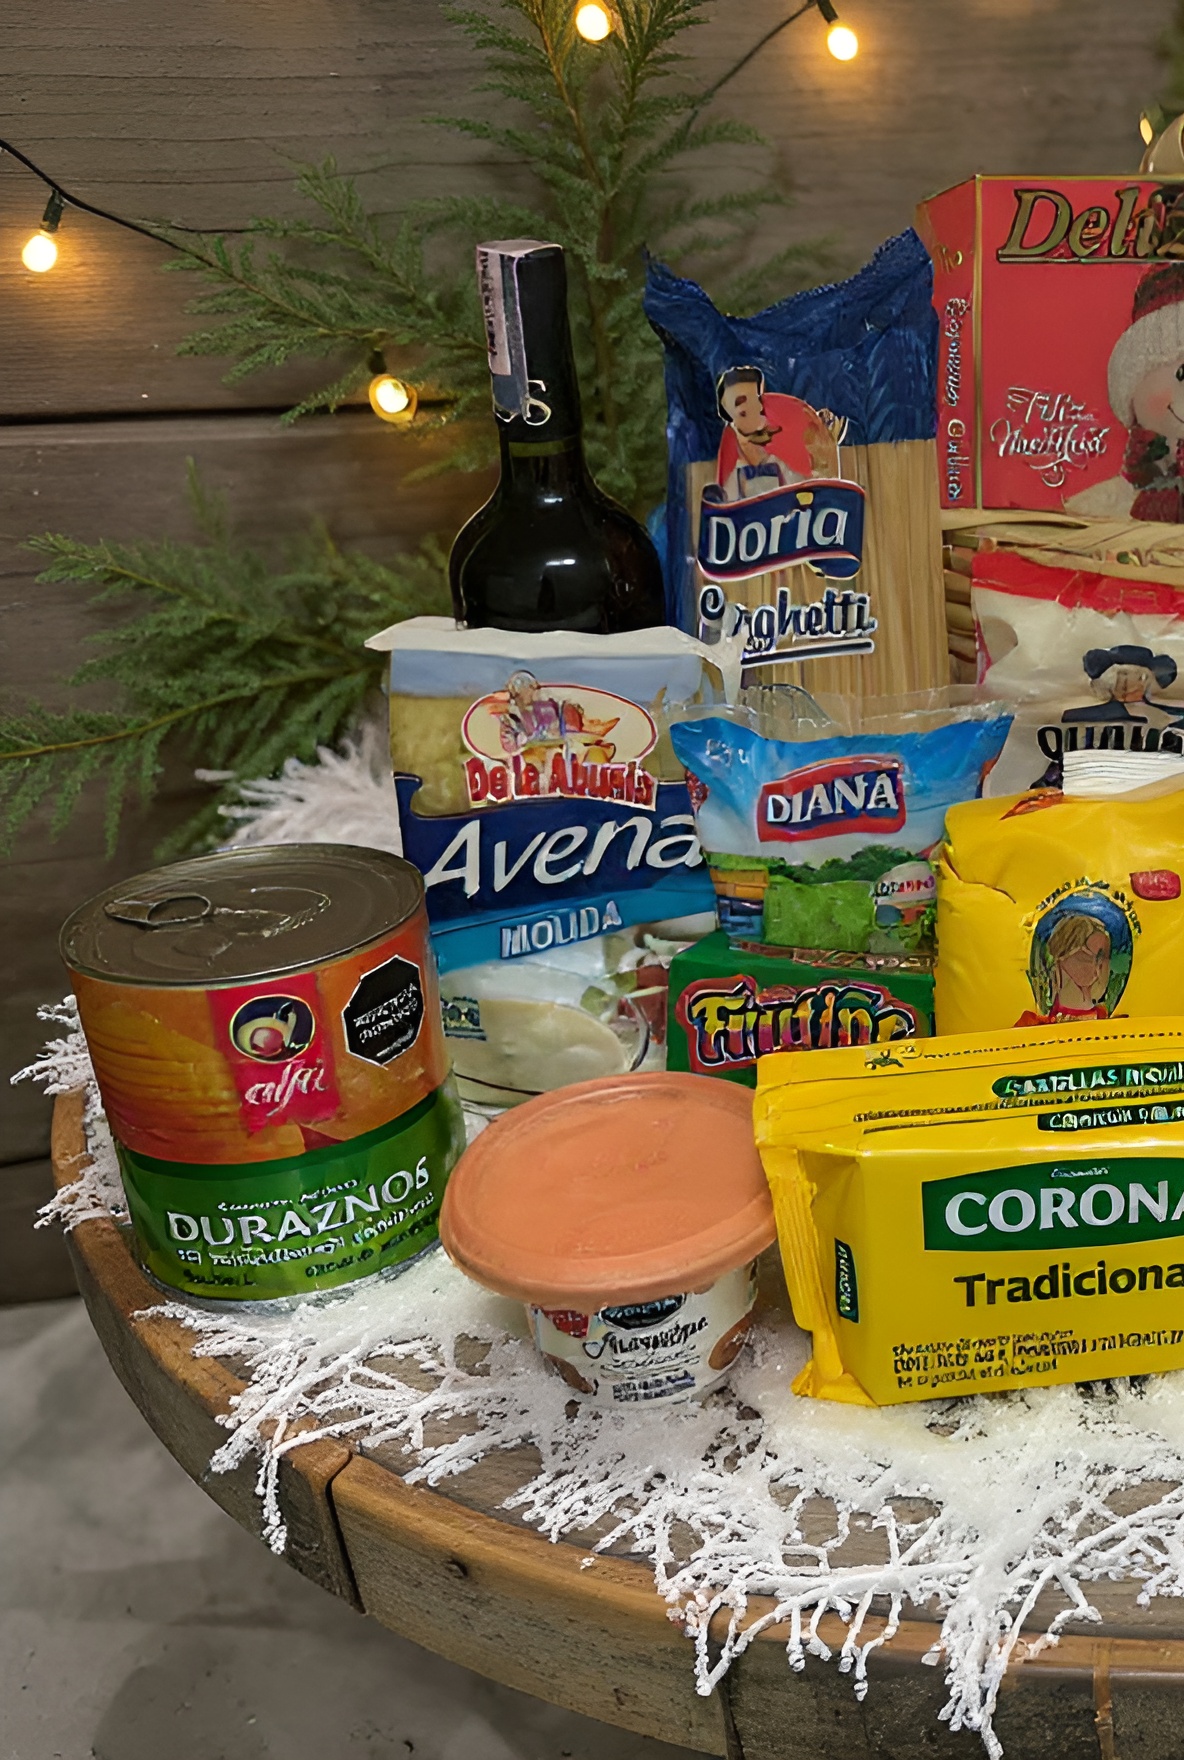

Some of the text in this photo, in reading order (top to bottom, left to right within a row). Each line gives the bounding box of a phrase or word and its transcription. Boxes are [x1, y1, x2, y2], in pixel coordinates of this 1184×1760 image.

[707, 494, 848, 567] Doria
[767, 772, 900, 823] DIANA
[425, 814, 703, 898] Avena
